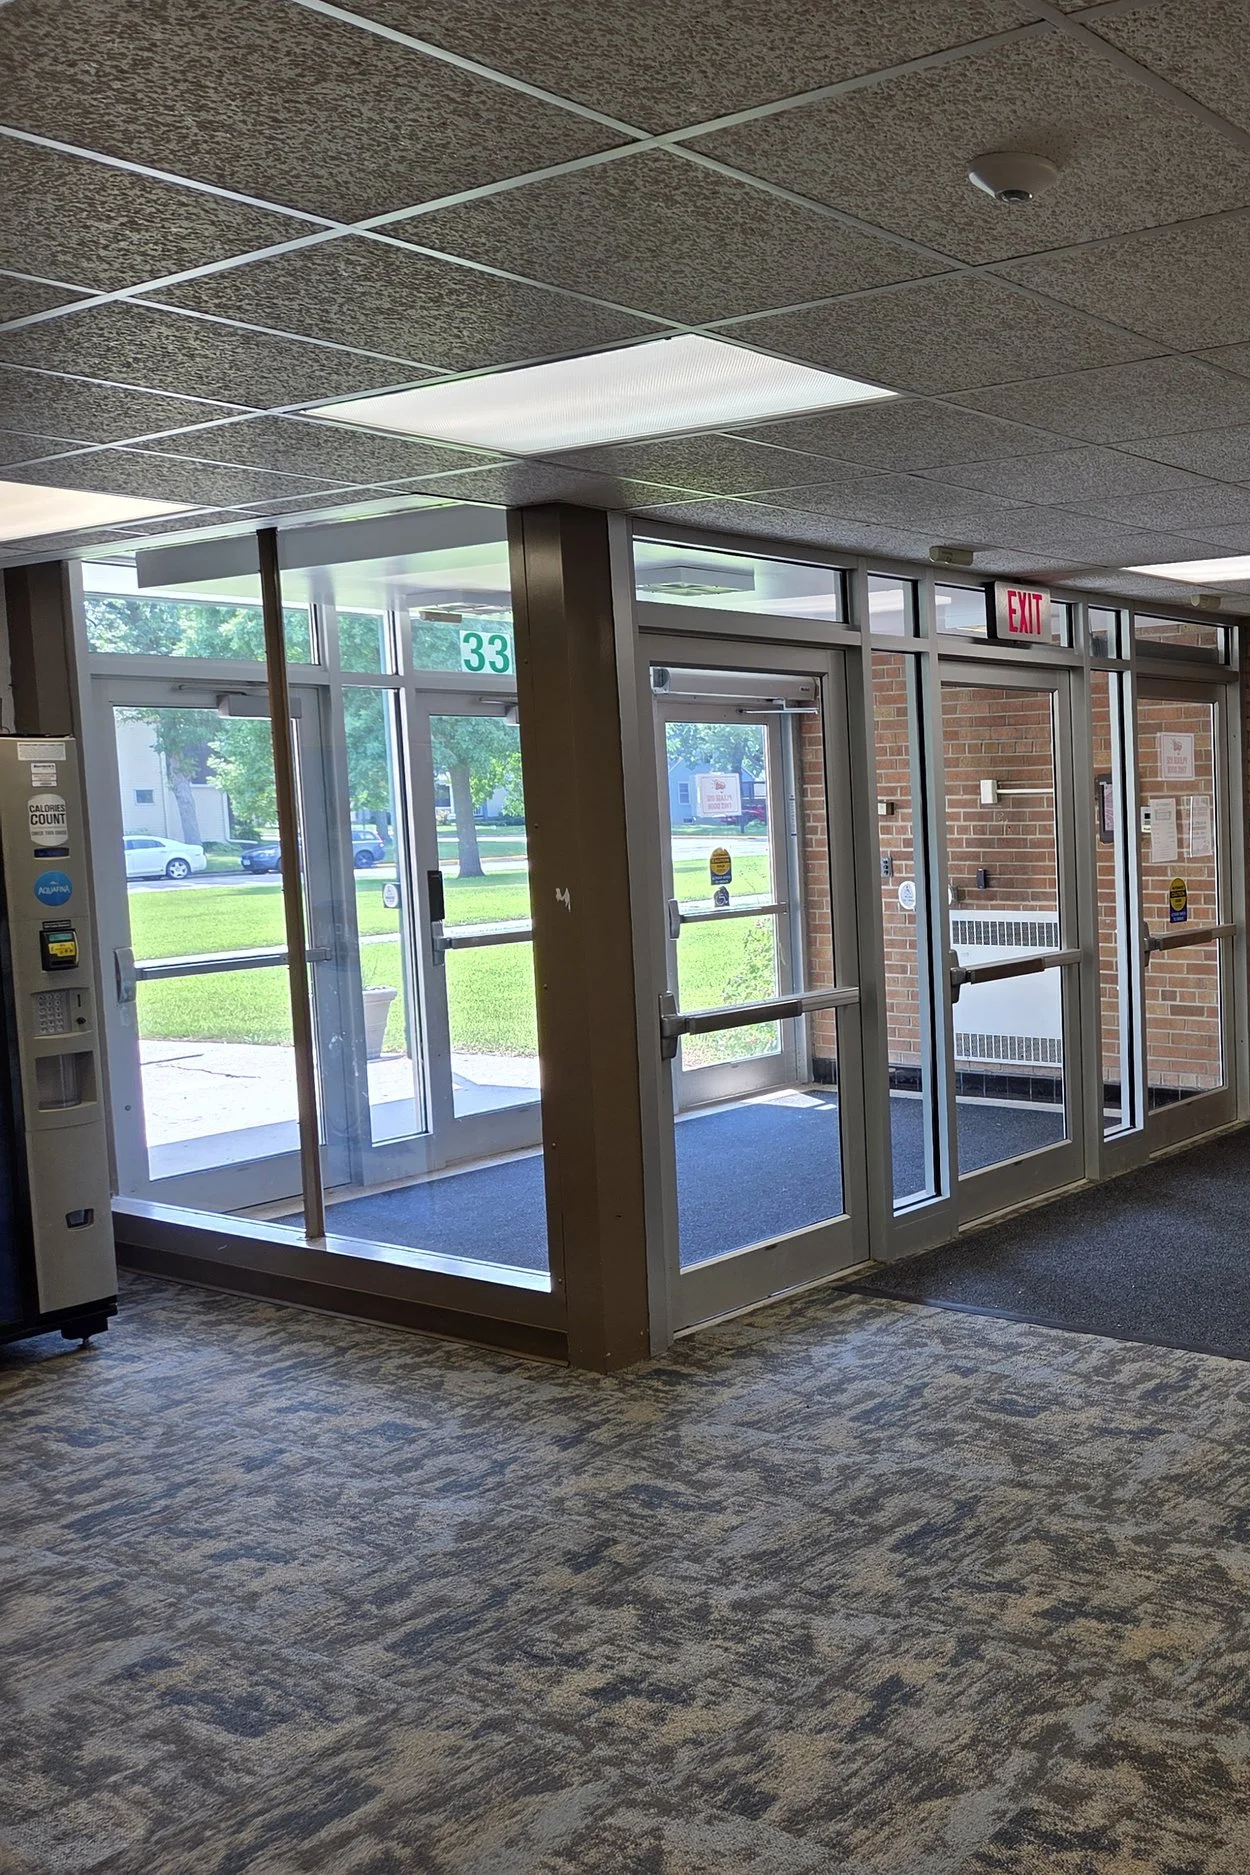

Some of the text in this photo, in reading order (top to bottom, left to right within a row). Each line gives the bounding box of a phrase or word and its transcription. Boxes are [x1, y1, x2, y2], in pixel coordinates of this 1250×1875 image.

[1007, 590, 1043, 635] EXIT
[463, 632, 510, 673] 33
[29, 804, 66, 813] CALORIES
[30, 813, 66, 825] COUNT
[38, 885, 70, 896] AQUAFINA
